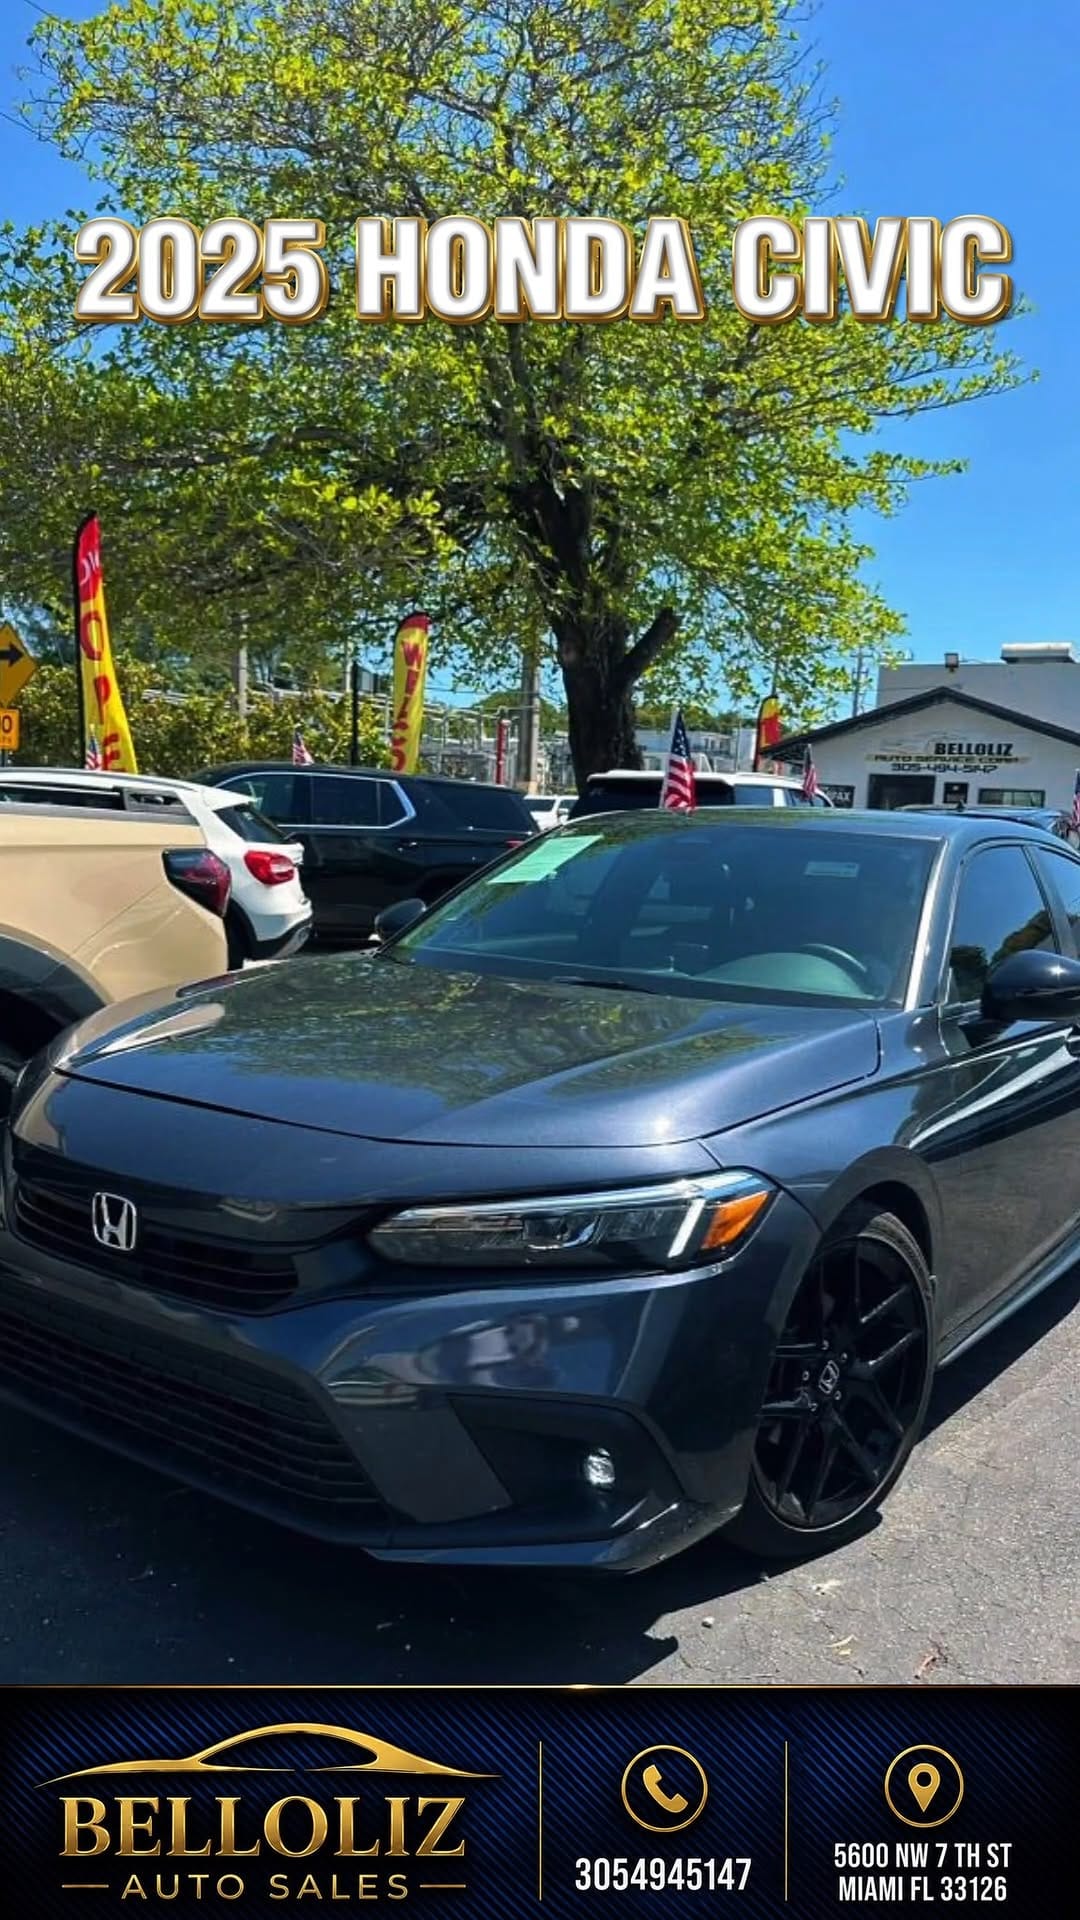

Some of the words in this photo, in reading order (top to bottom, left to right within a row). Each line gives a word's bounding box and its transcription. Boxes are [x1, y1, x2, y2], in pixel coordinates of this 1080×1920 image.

[933, 742, 1014, 757] BELLOLIZ
[874, 754, 913, 763] AUTO
[915, 754, 974, 763] SERVICE
